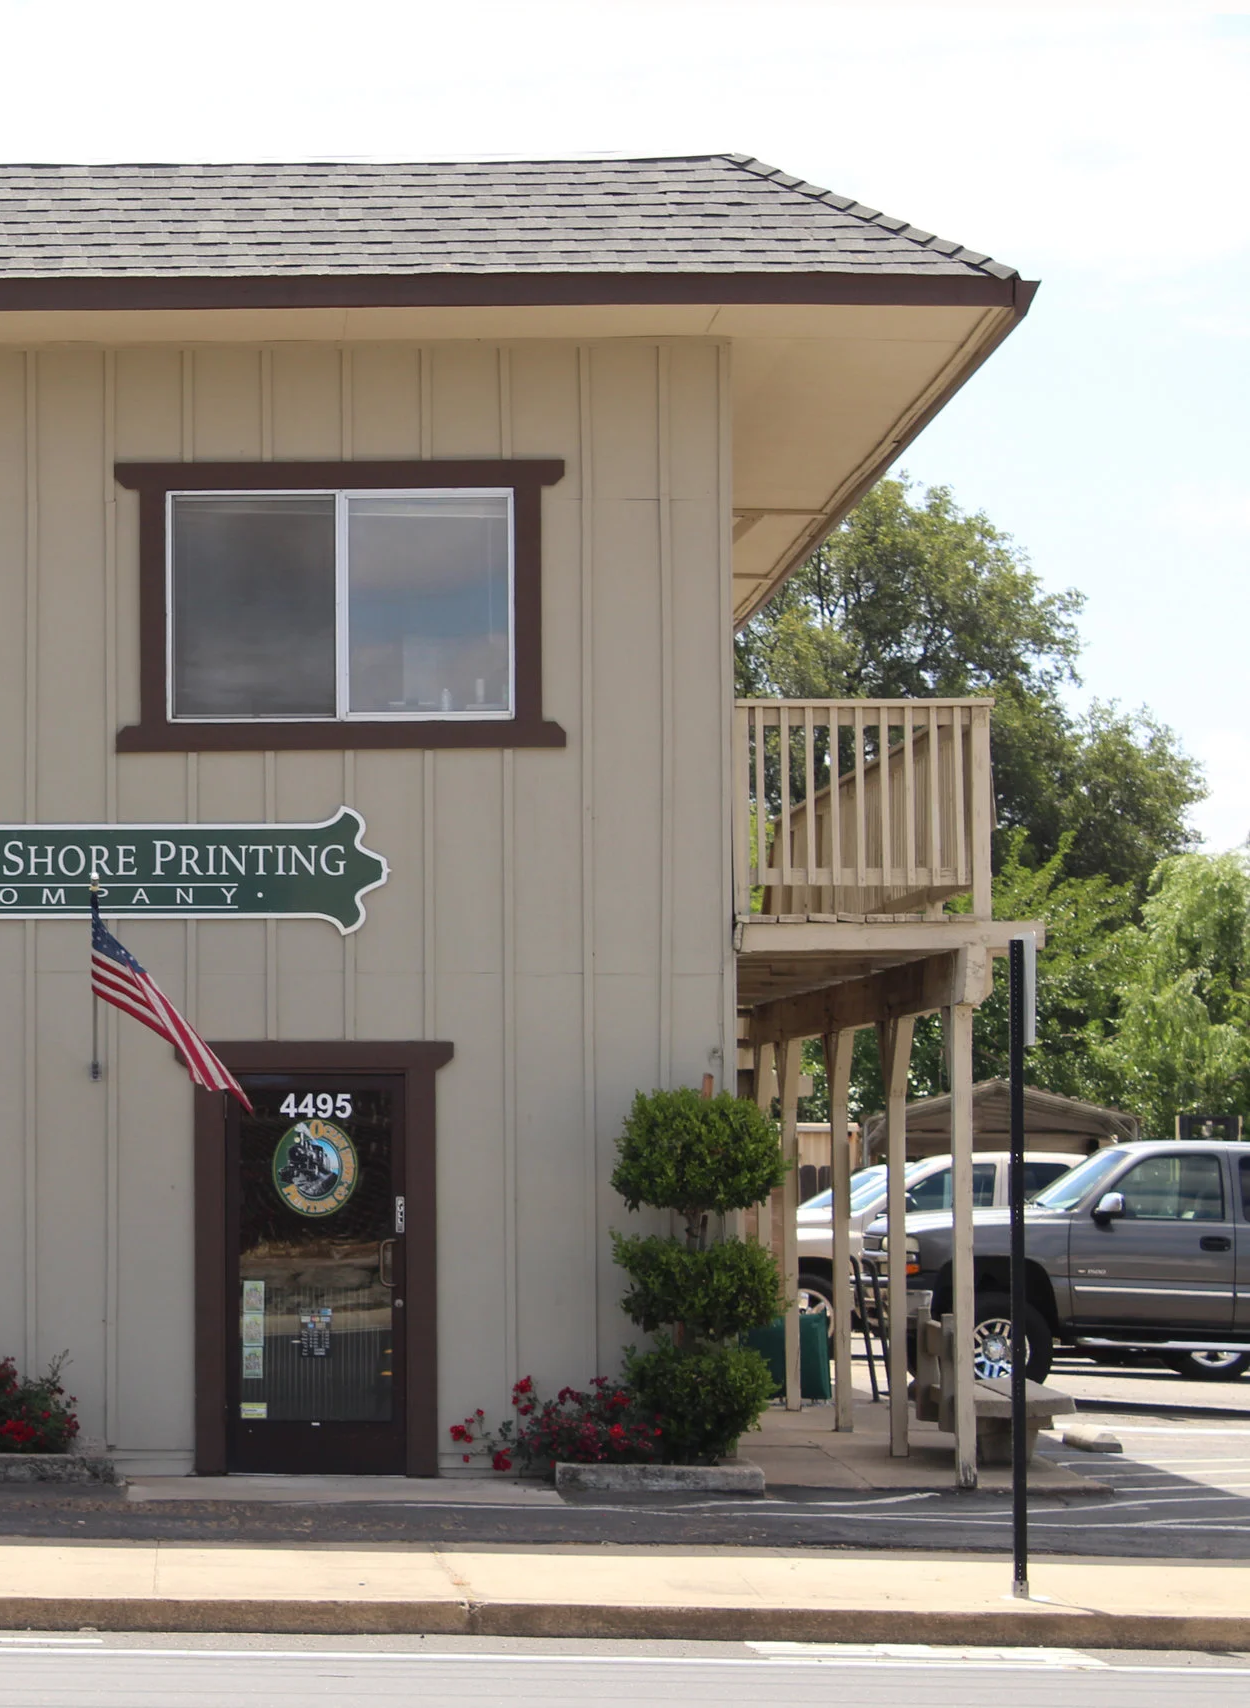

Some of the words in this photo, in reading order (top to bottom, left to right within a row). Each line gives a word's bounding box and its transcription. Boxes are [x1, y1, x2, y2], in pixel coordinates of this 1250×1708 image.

[2, 840, 138, 877] SHORE
[152, 840, 346, 877] PRINTING
[279, 1092, 353, 1118] 4495
